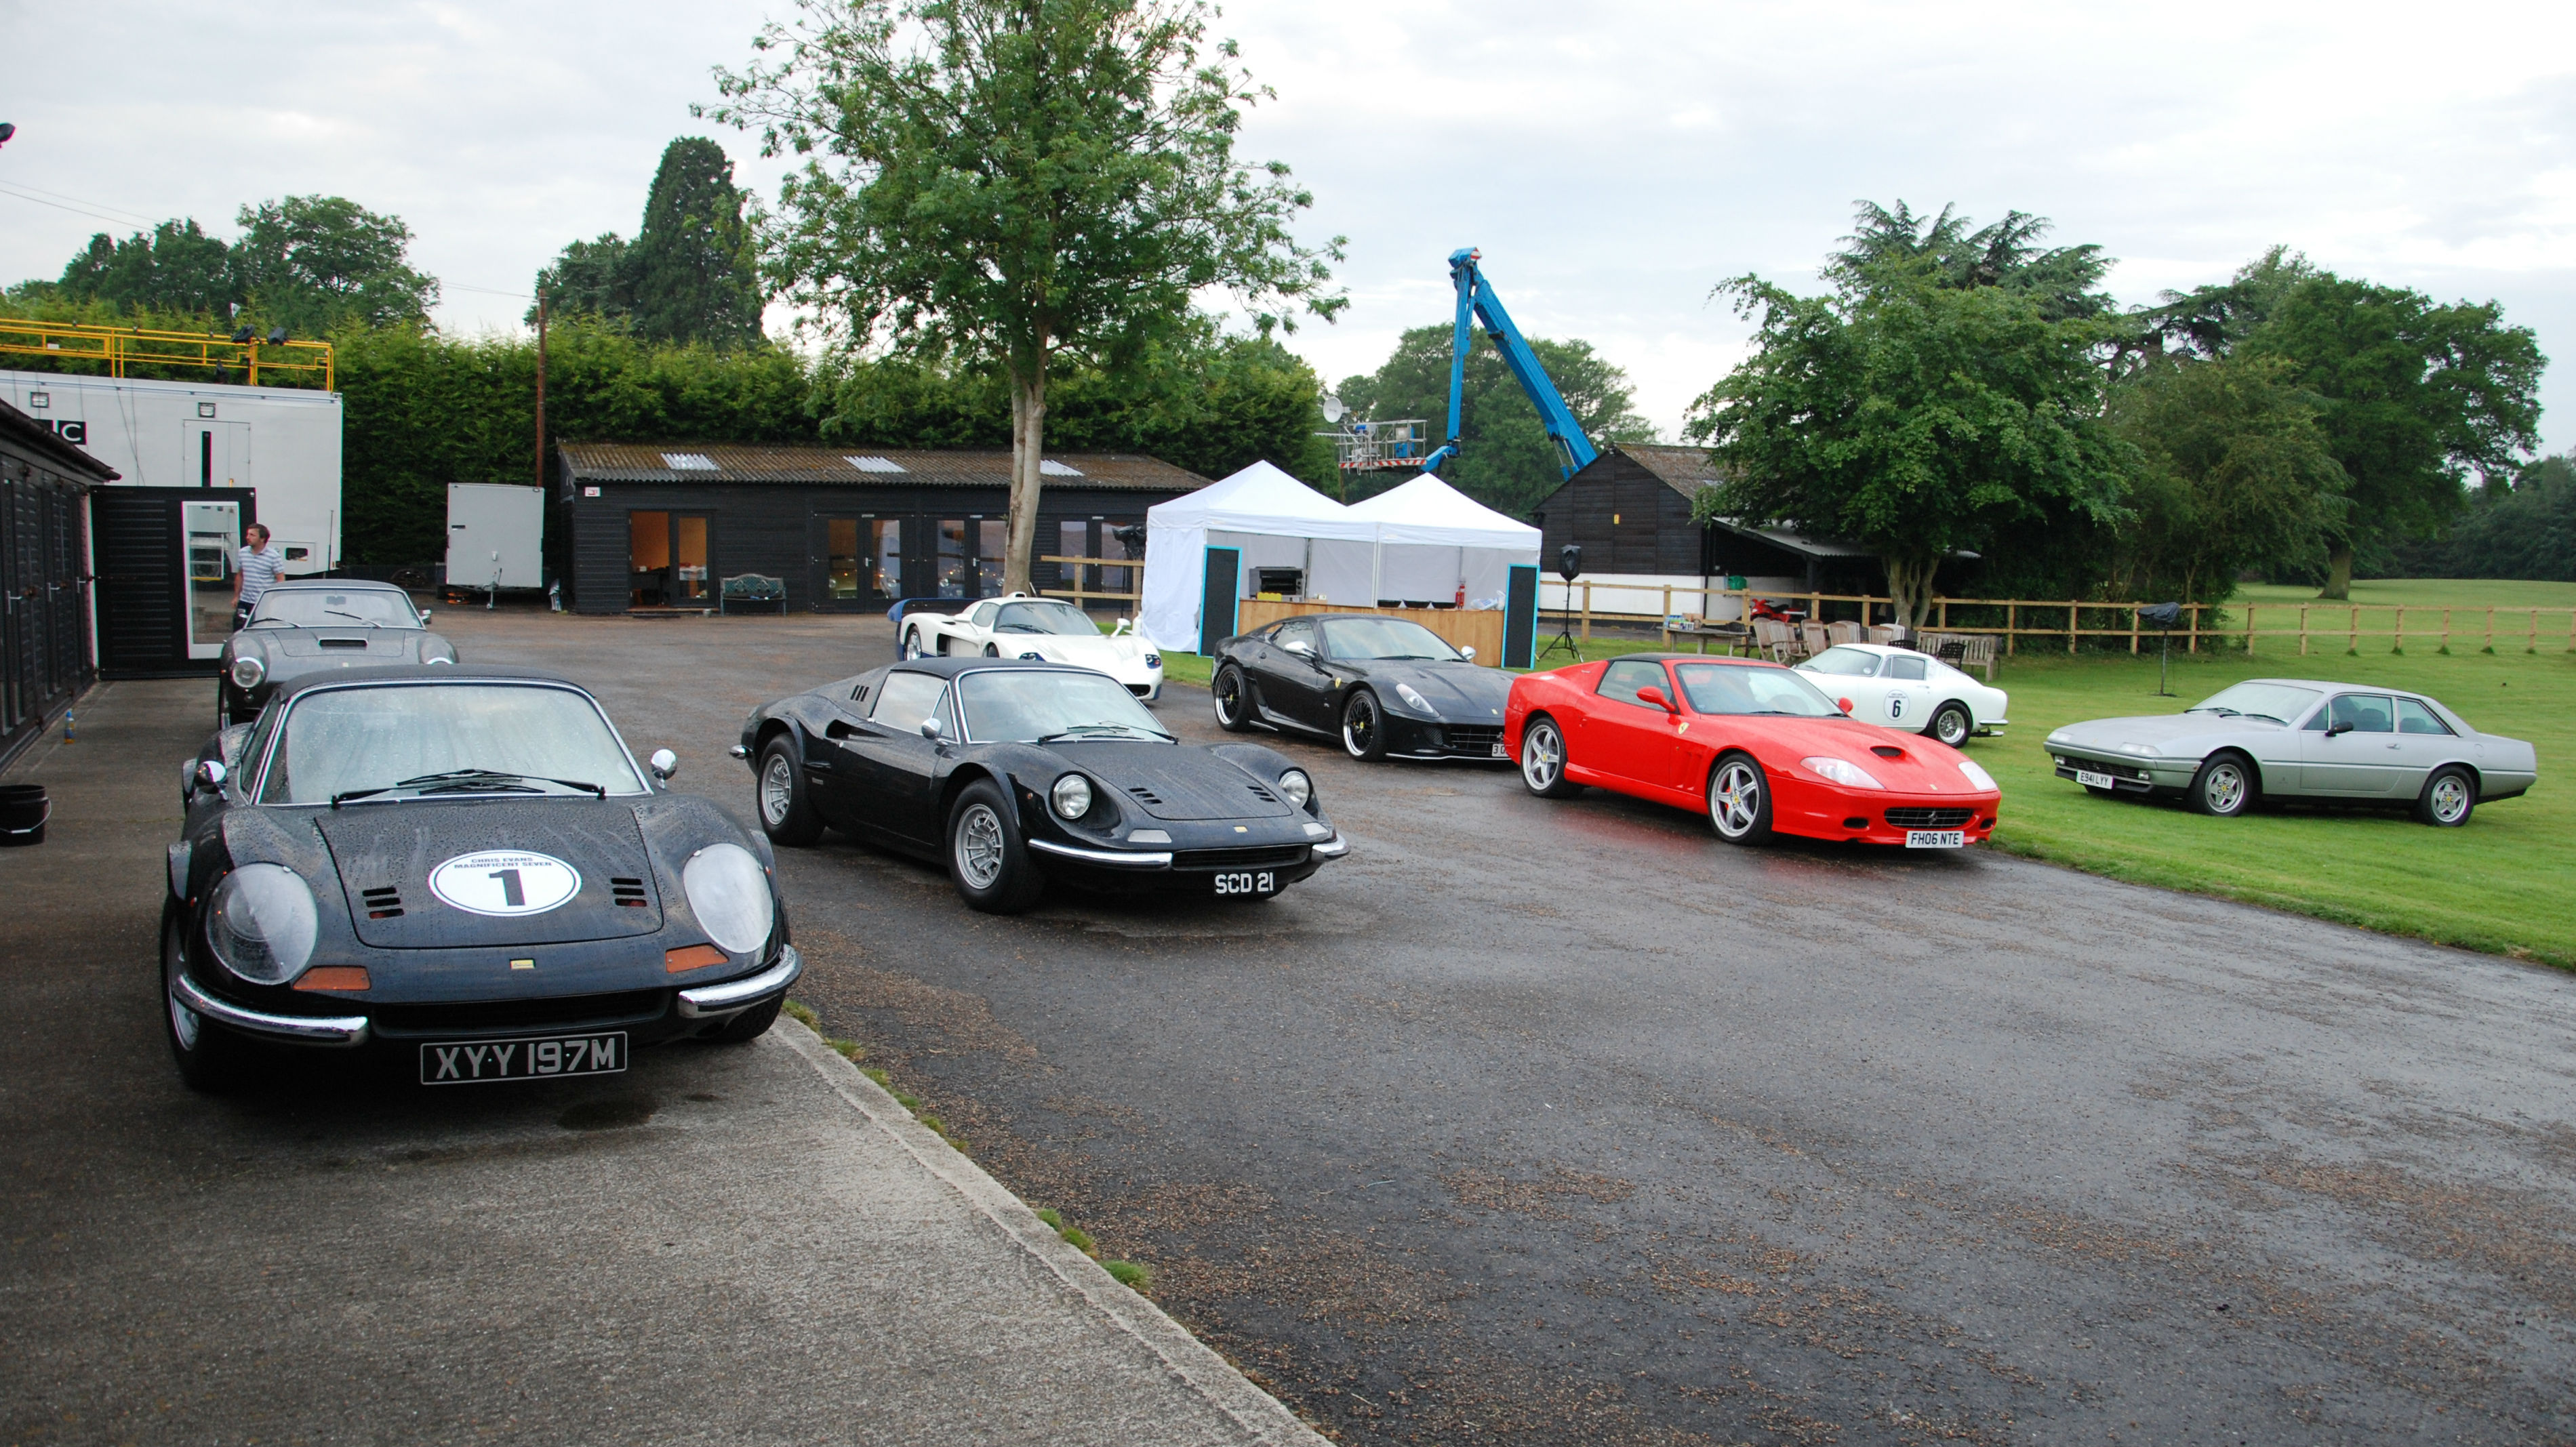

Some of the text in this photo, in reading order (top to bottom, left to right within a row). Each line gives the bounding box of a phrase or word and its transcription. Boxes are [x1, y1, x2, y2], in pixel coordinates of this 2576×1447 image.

[1892, 699, 1901, 718] 6
[1910, 833, 1960, 845] FH06 NTE
[489, 869, 525, 906] 1
[1215, 872, 1273, 894] SCD 21
[436, 1038, 615, 1079] XYY 197M
